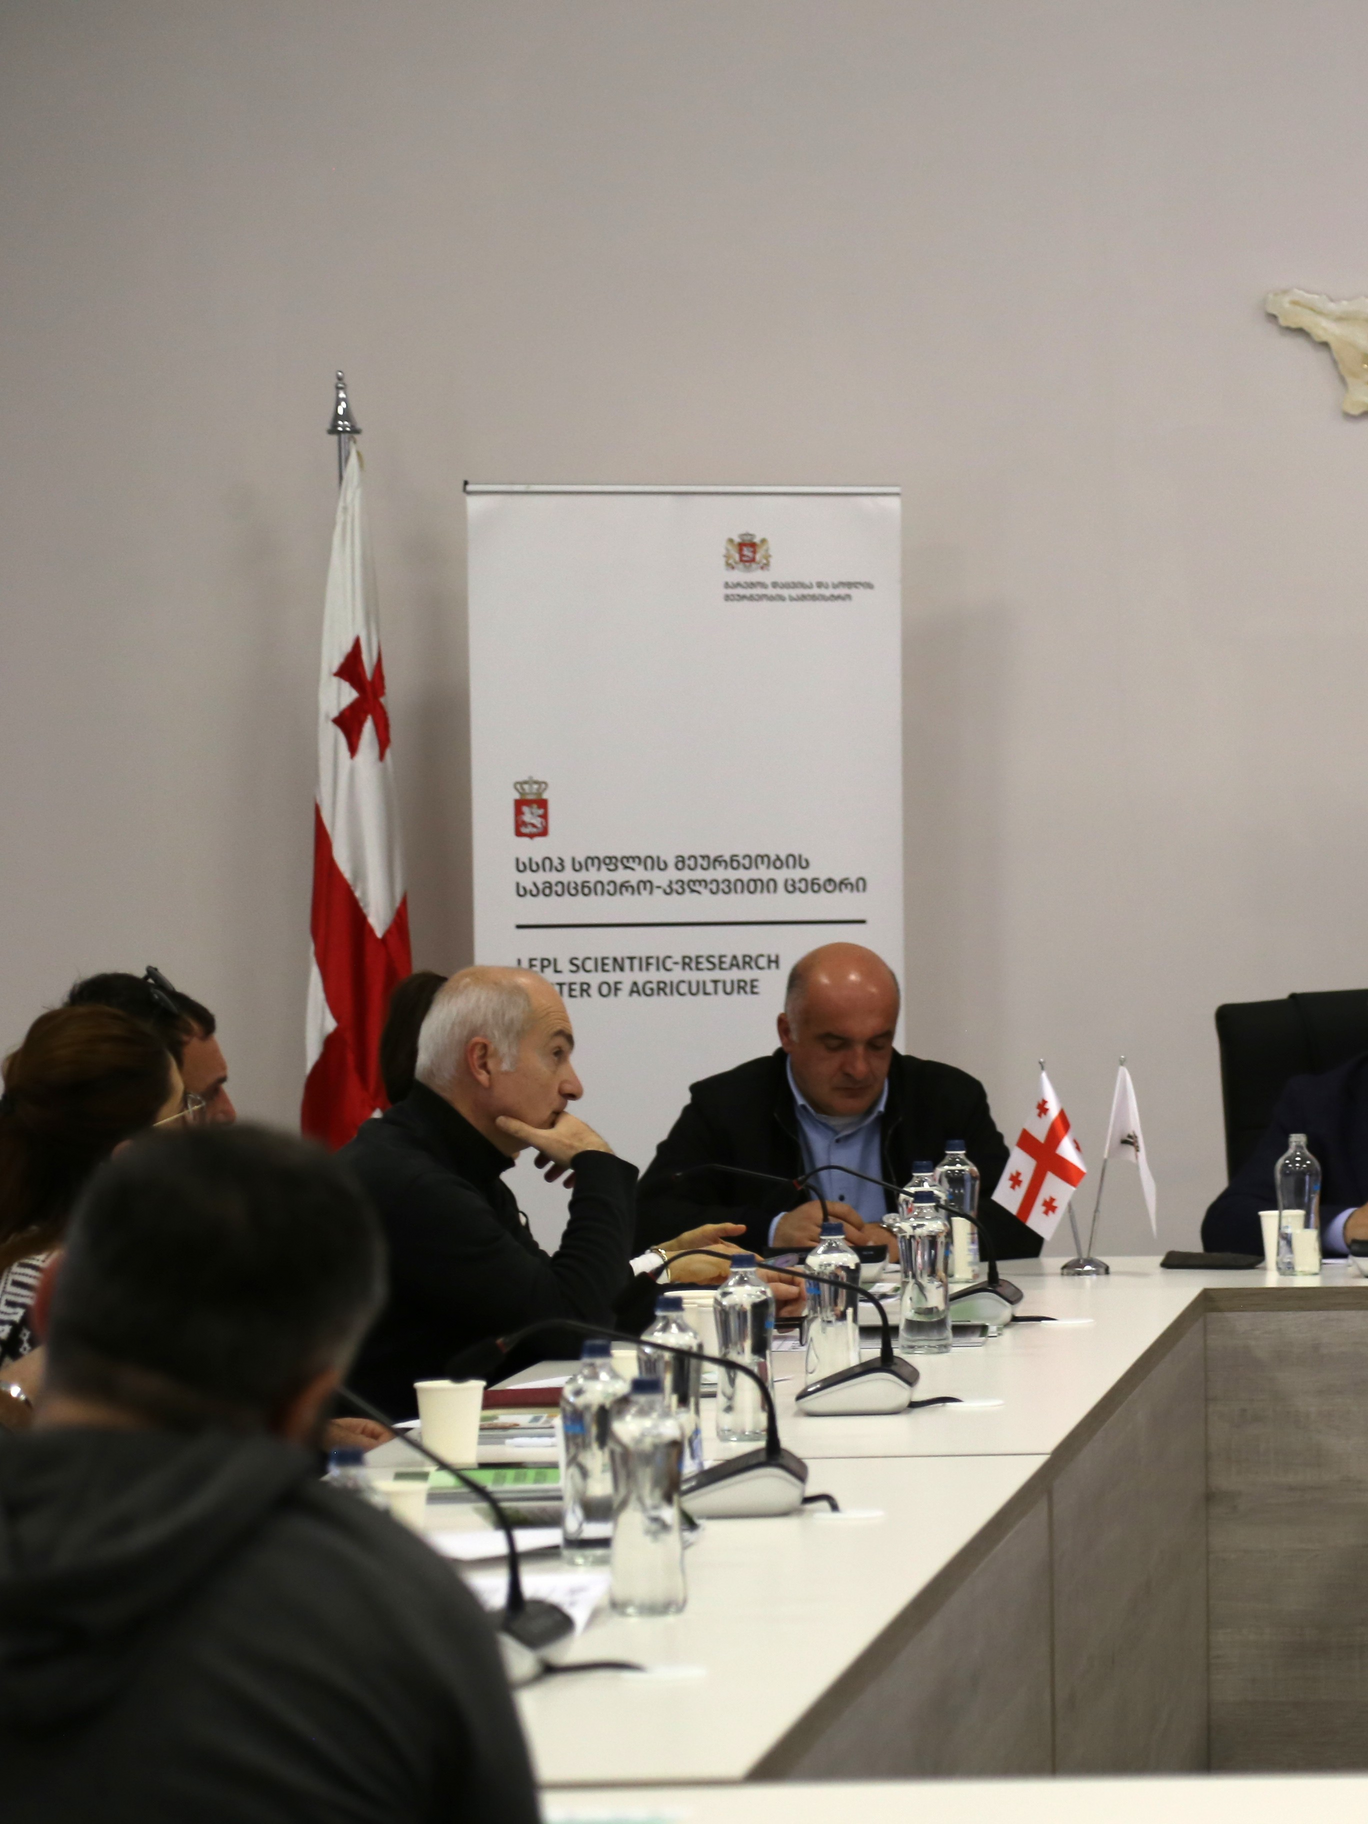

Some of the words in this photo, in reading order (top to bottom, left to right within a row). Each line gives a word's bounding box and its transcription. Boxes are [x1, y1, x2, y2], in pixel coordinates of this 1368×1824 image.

[515, 856, 566, 874] სსიპ
[571, 855, 669, 873] სოფლის
[674, 853, 810, 872] მეურნეობის
[515, 877, 778, 898] სამეცნიერო-კვლევითი
[783, 876, 867, 895] ცენტრი
[568, 953, 780, 974] SCIENTIFIC-RESEARCH
[597, 980, 623, 998] OF
[628, 978, 759, 998] AGRICULTURE
